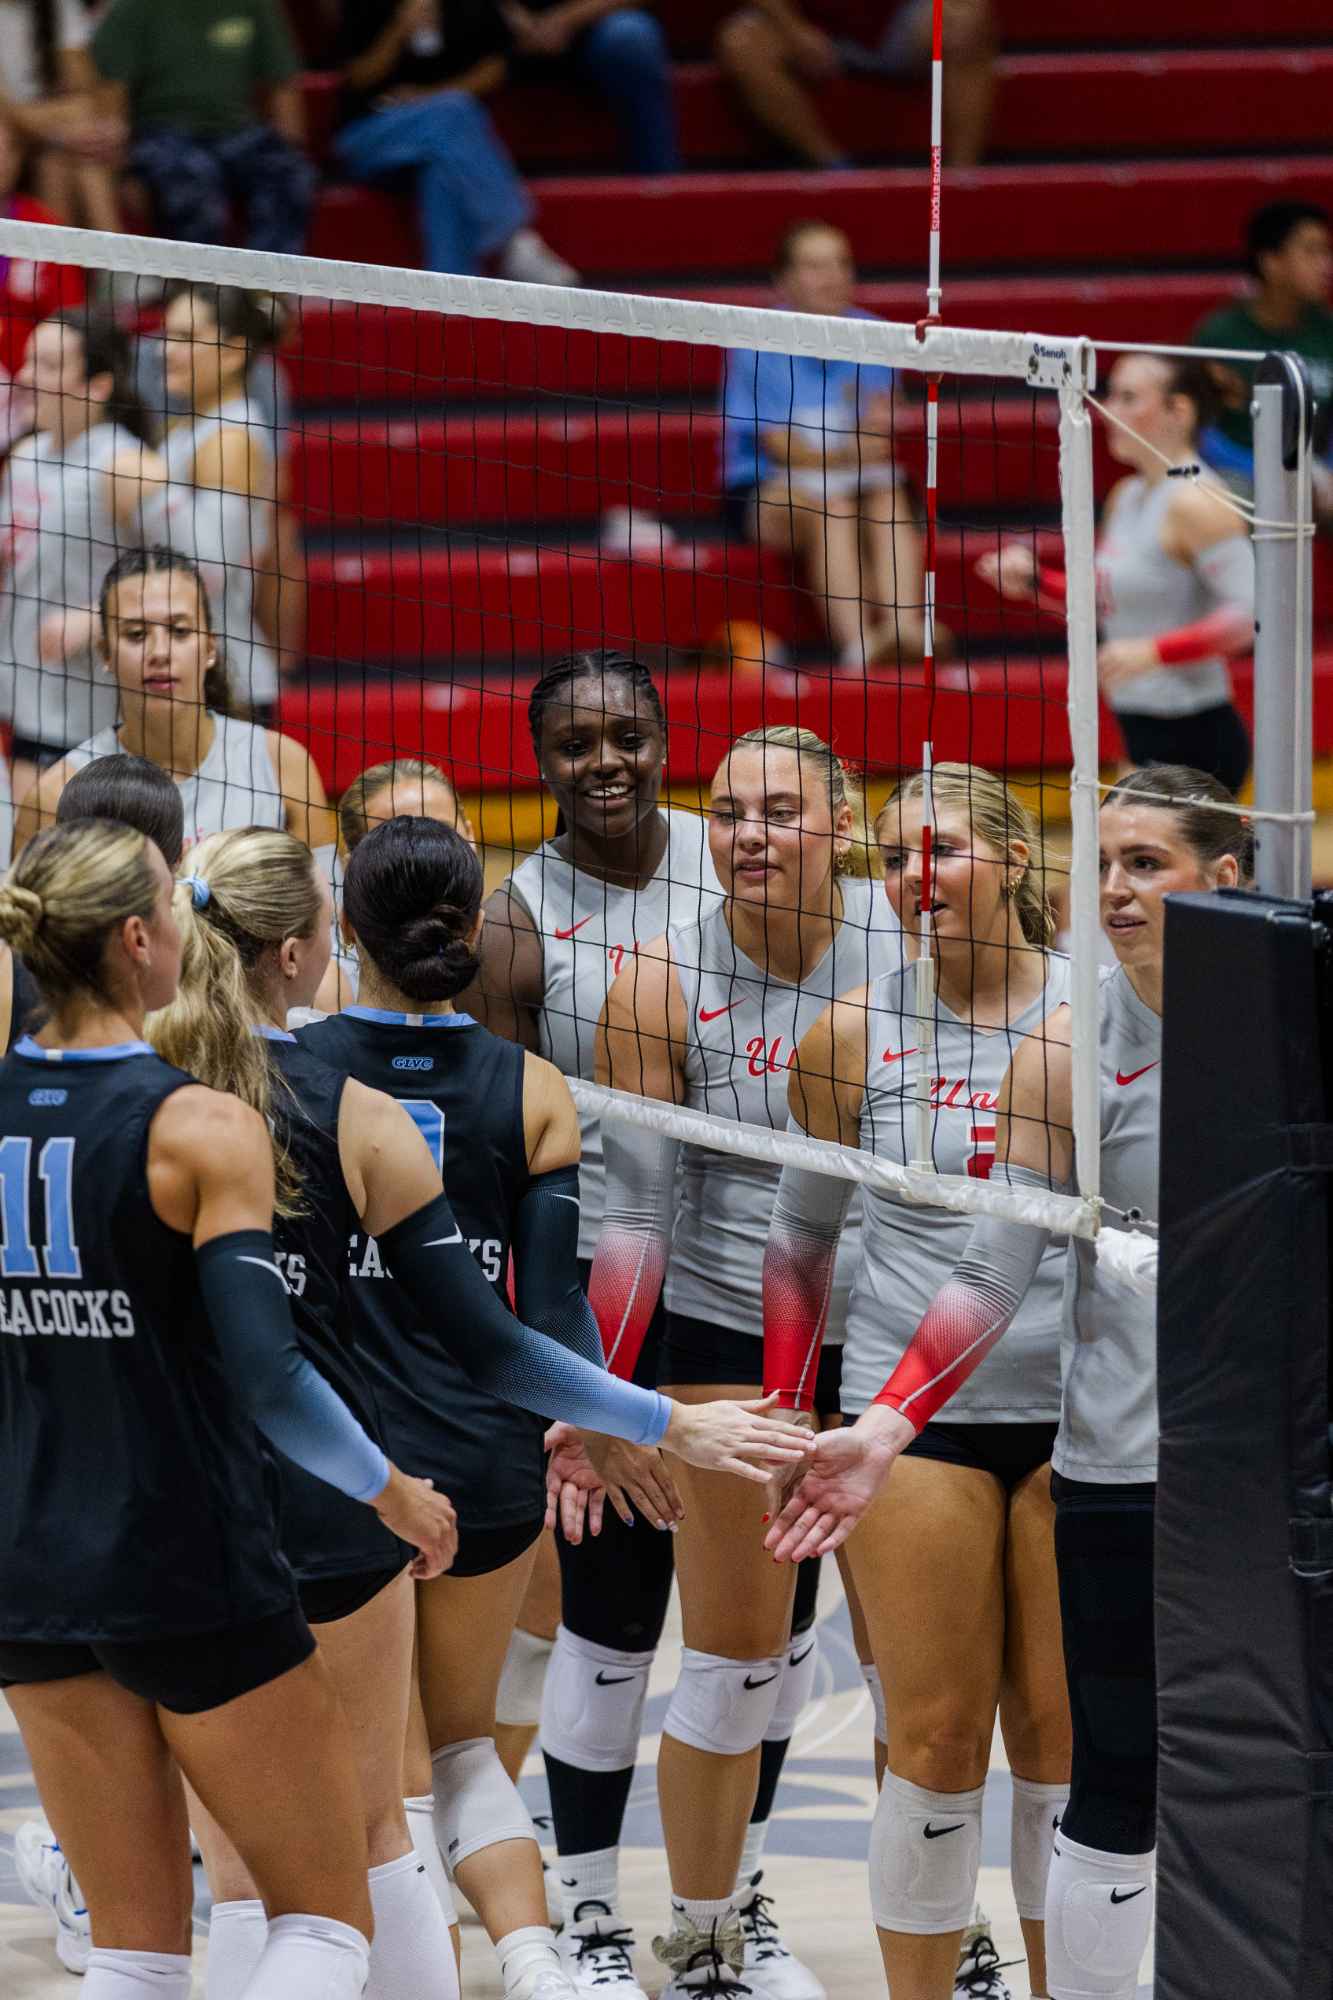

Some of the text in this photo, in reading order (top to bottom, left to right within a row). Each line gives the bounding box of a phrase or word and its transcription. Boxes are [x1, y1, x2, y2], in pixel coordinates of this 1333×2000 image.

[931, 147, 941, 230] sports imports
[1040, 345, 1067, 360] Senoh
[392, 1056, 434, 1071] GLVC
[0, 1136, 83, 1279] 11
